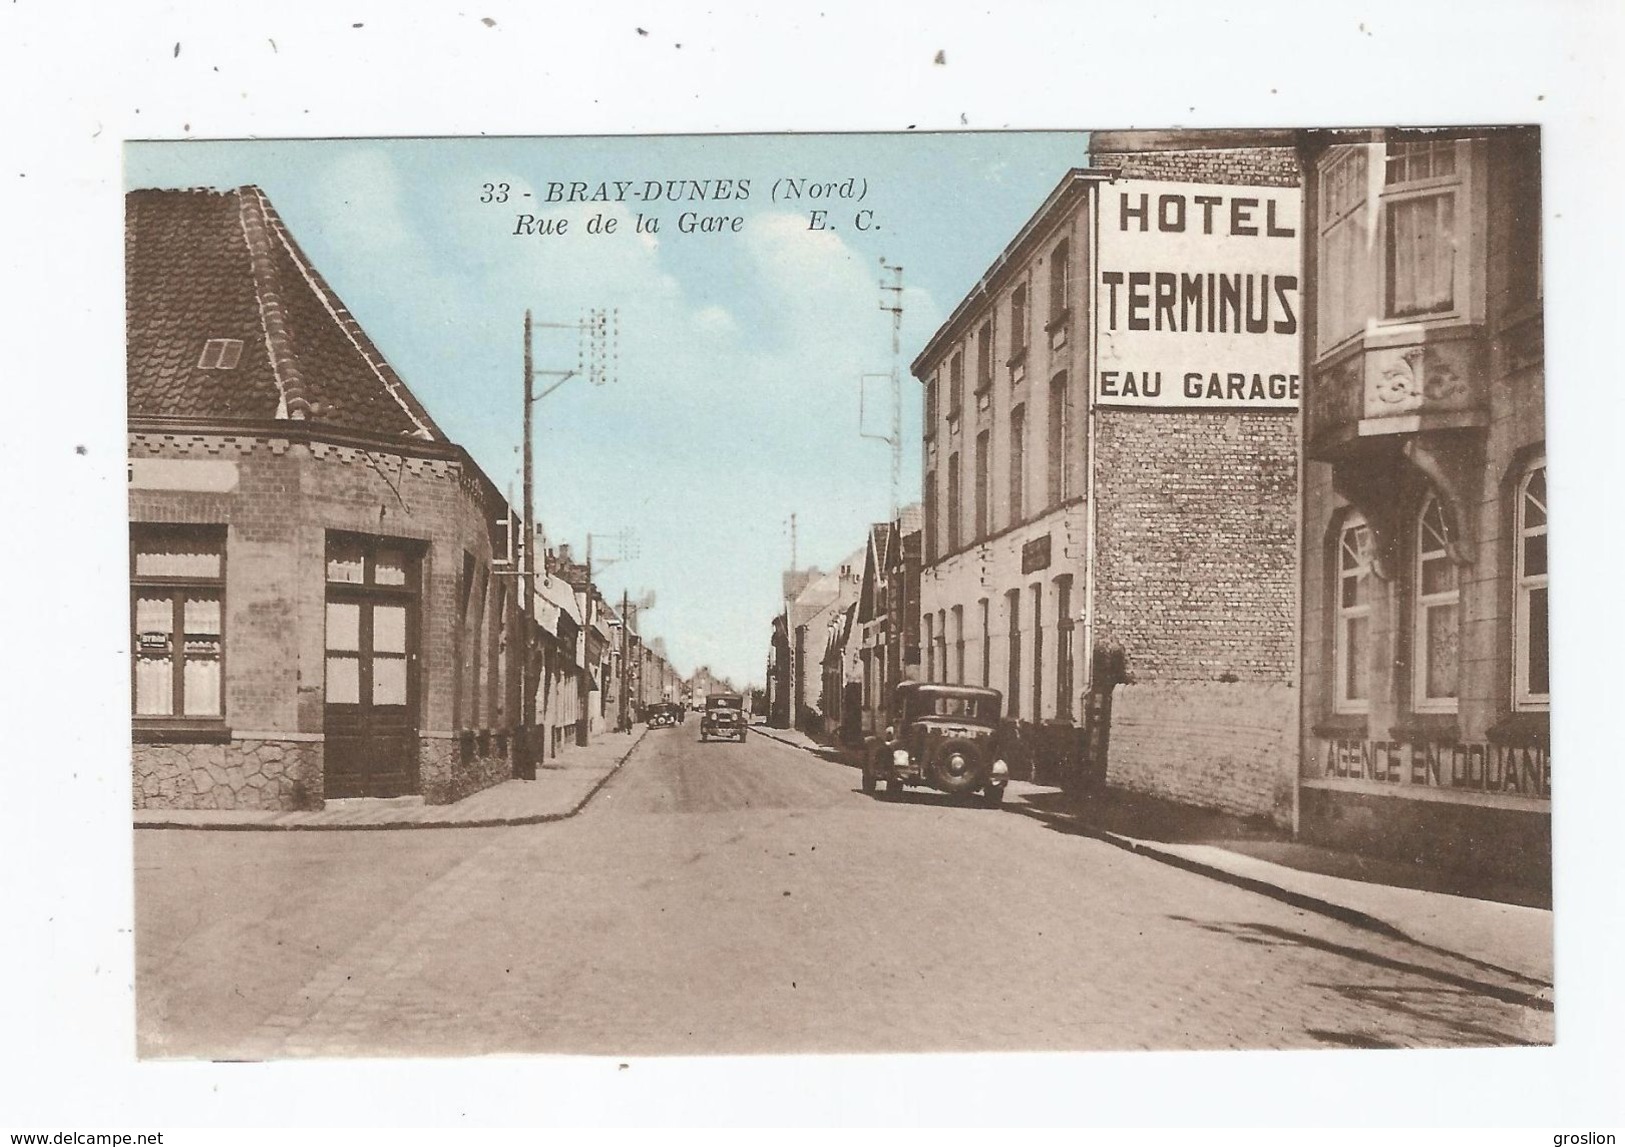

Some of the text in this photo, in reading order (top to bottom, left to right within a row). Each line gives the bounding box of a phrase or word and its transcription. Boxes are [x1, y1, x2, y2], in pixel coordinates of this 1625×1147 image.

[1119, 192, 1296, 238] HOTEL
[1102, 271, 1298, 335] TERMINUS
[1100, 371, 1161, 397] EAU
[1325, 739, 1401, 782] AGENCE
[1411, 741, 1442, 786] EN
